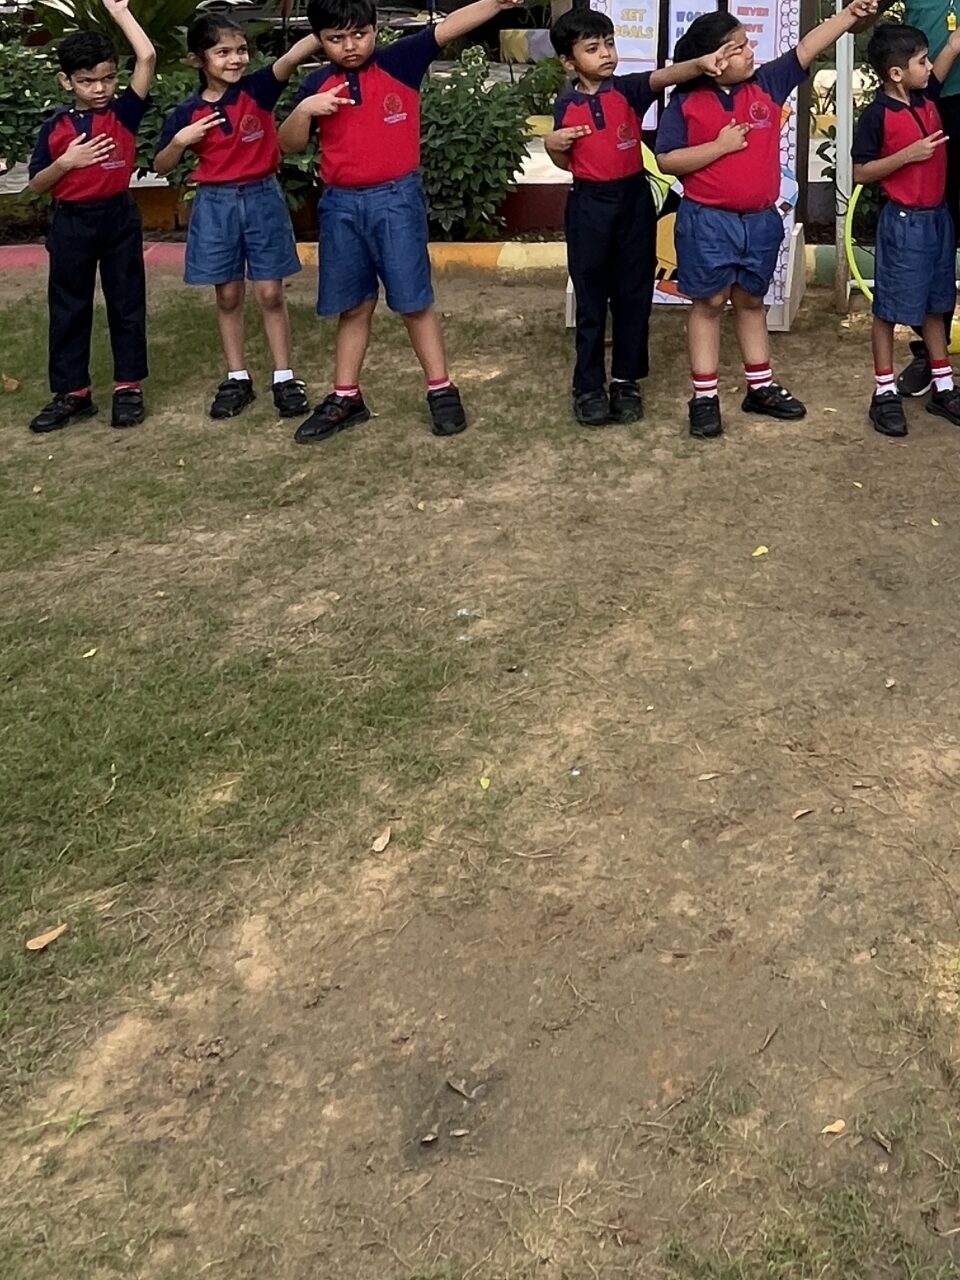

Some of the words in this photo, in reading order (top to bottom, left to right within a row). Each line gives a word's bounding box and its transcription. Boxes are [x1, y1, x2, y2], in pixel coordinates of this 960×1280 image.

[621, 8, 647, 22] SET
[676, 10, 706, 23] WO
[737, 6, 770, 17] NEVER
[744, 23, 764, 33] IVE
